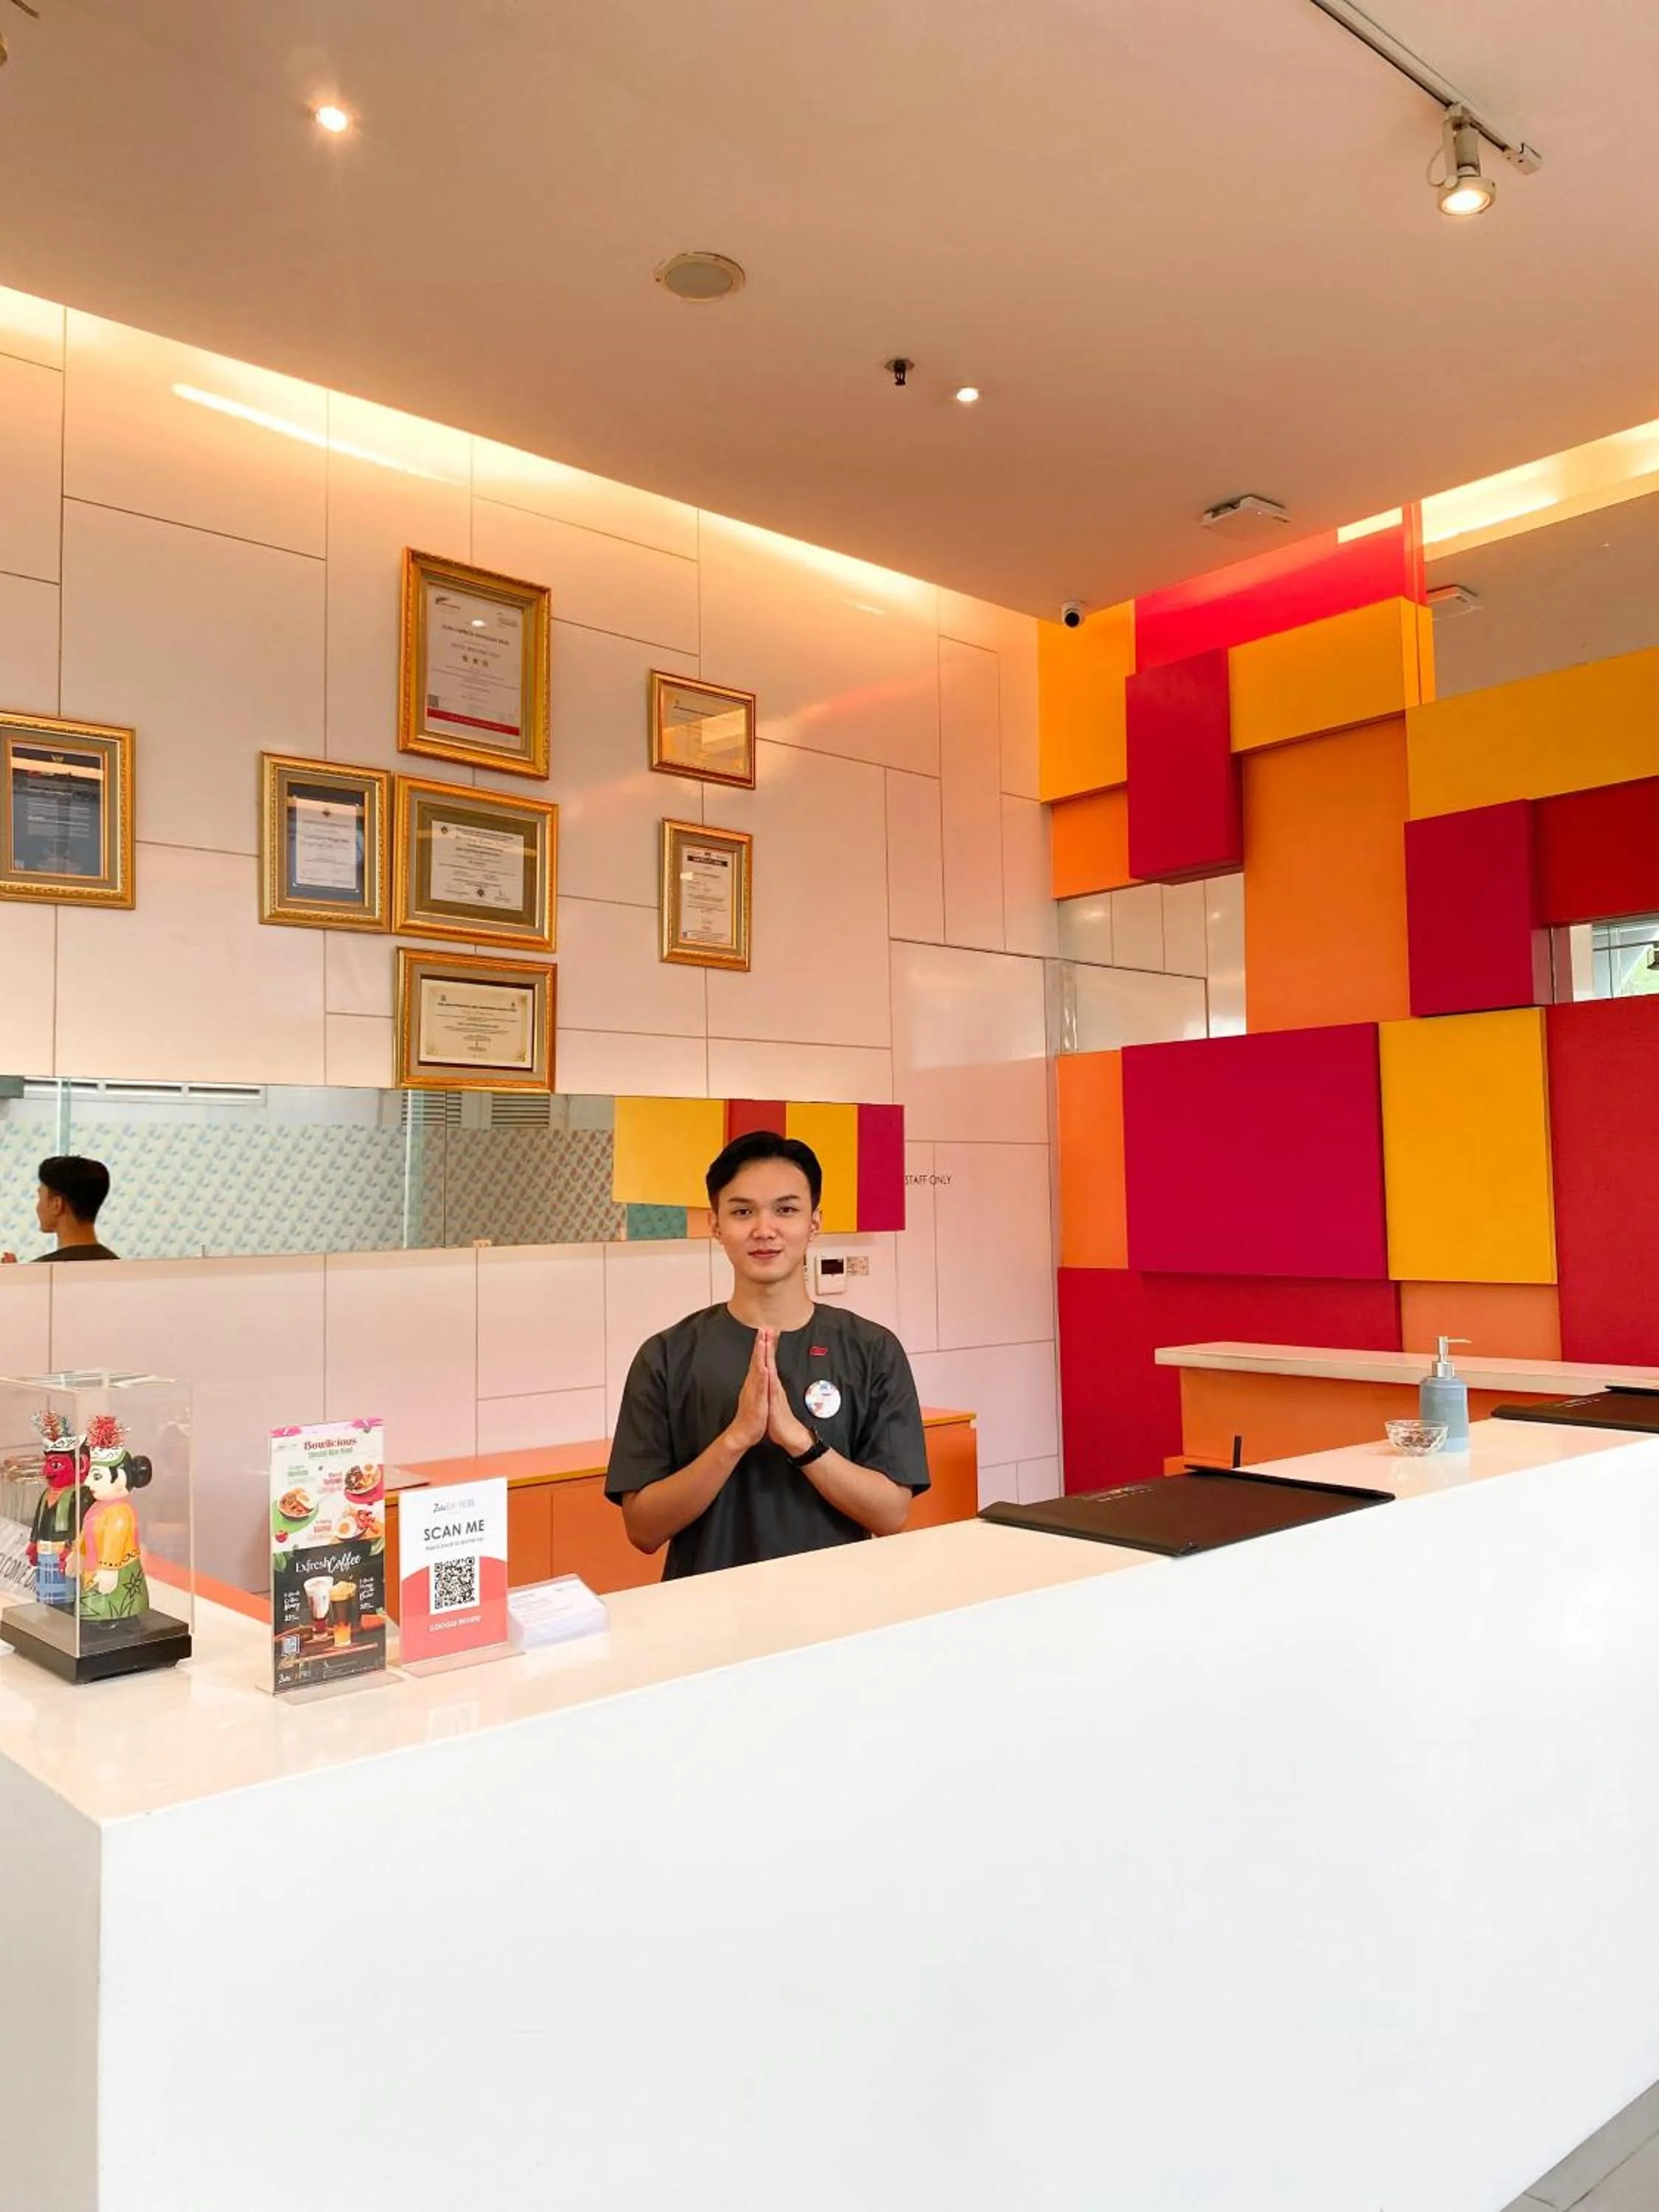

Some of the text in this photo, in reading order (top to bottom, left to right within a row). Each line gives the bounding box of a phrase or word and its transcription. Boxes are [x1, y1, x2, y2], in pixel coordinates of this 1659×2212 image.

[904, 1174, 952, 1186] STAFF ONLY
[424, 1520, 484, 1541] SCAN ME
